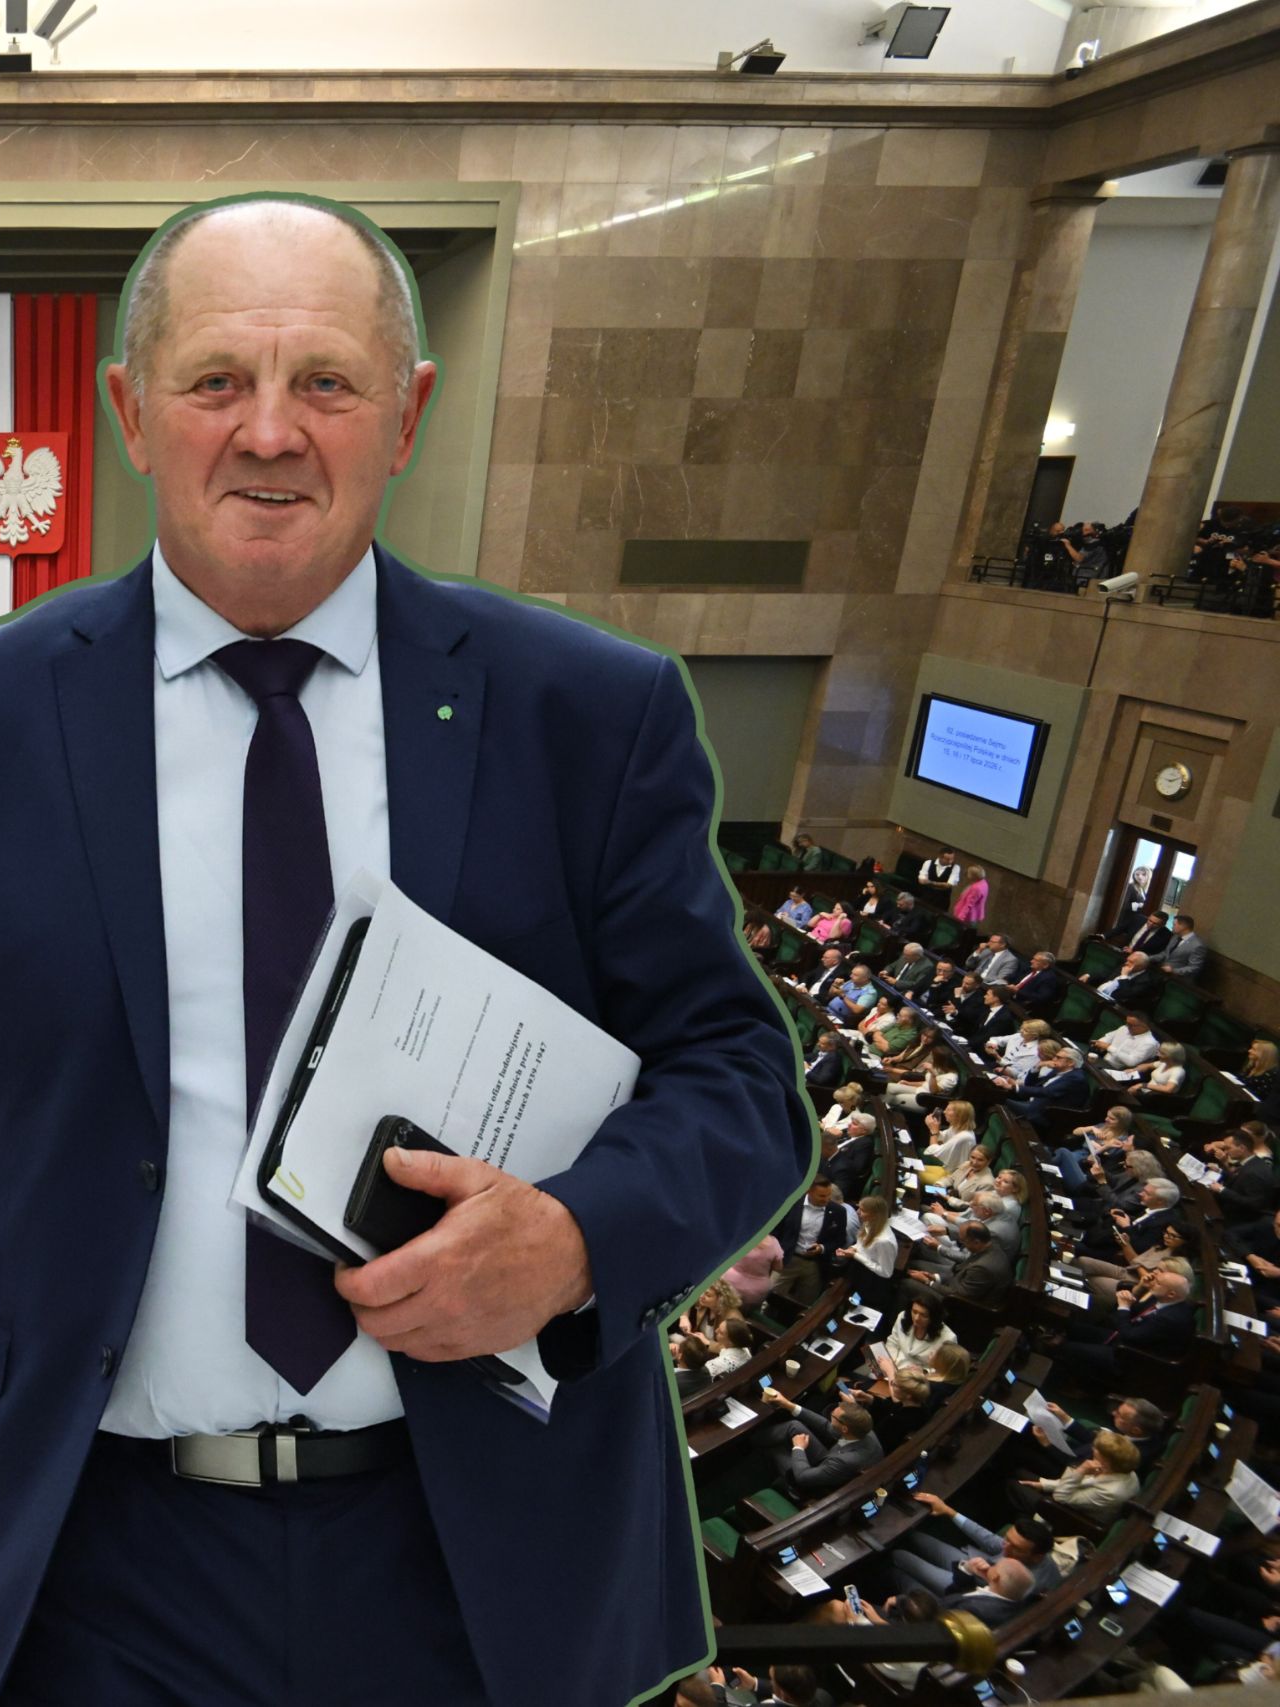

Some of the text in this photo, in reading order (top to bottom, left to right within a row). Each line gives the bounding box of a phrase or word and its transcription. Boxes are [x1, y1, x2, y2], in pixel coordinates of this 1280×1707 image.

[470, 1021, 524, 1157] nia pamięci ofiar ludobójstwa
[496, 1068, 523, 1124] Wschodnich
[514, 1091, 530, 1121] latach
